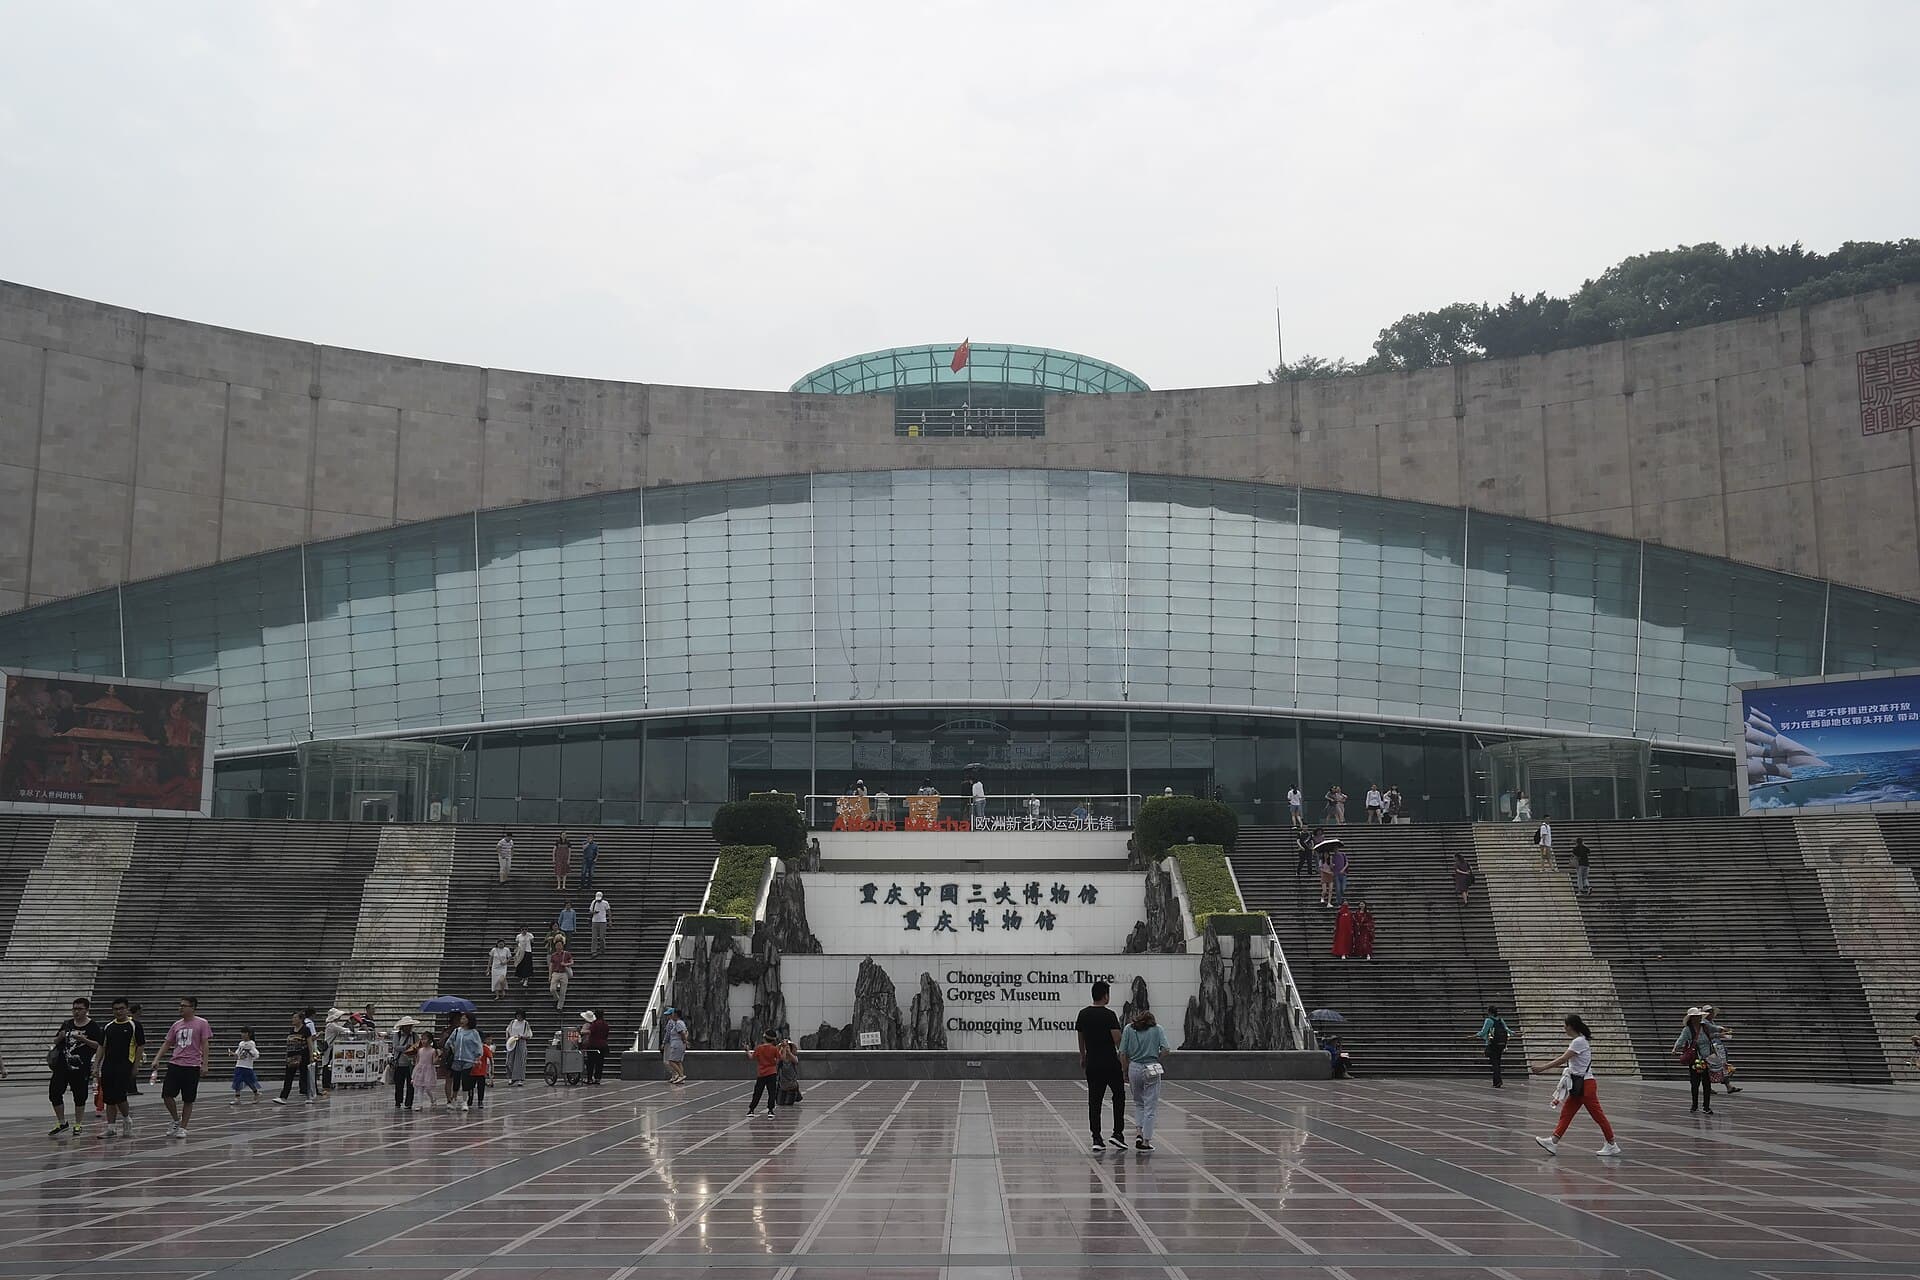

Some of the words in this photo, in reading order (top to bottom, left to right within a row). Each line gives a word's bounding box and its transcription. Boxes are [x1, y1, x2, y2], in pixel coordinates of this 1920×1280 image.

[1806, 702, 1911, 718] 坚定不移推进改革开放
[1780, 714, 1894, 731] 努力在西部地区带头开放
[1897, 712, 1920, 722] 带动
[975, 815, 1114, 832] 欧洲新艺术运动先锋
[859, 881, 1099, 906] 重庆中国三峡博物馆
[903, 908, 1057, 933] 重庆博物馆
[946, 970, 1022, 987] Chongqing
[1026, 970, 1069, 984] China
[1073, 970, 1114, 983] Three
[946, 987, 996, 1003] Gorges
[1000, 988, 1060, 1001] Museum
[946, 1017, 1023, 1034] Chongqing
[1028, 1017, 1079, 1031] Museu
